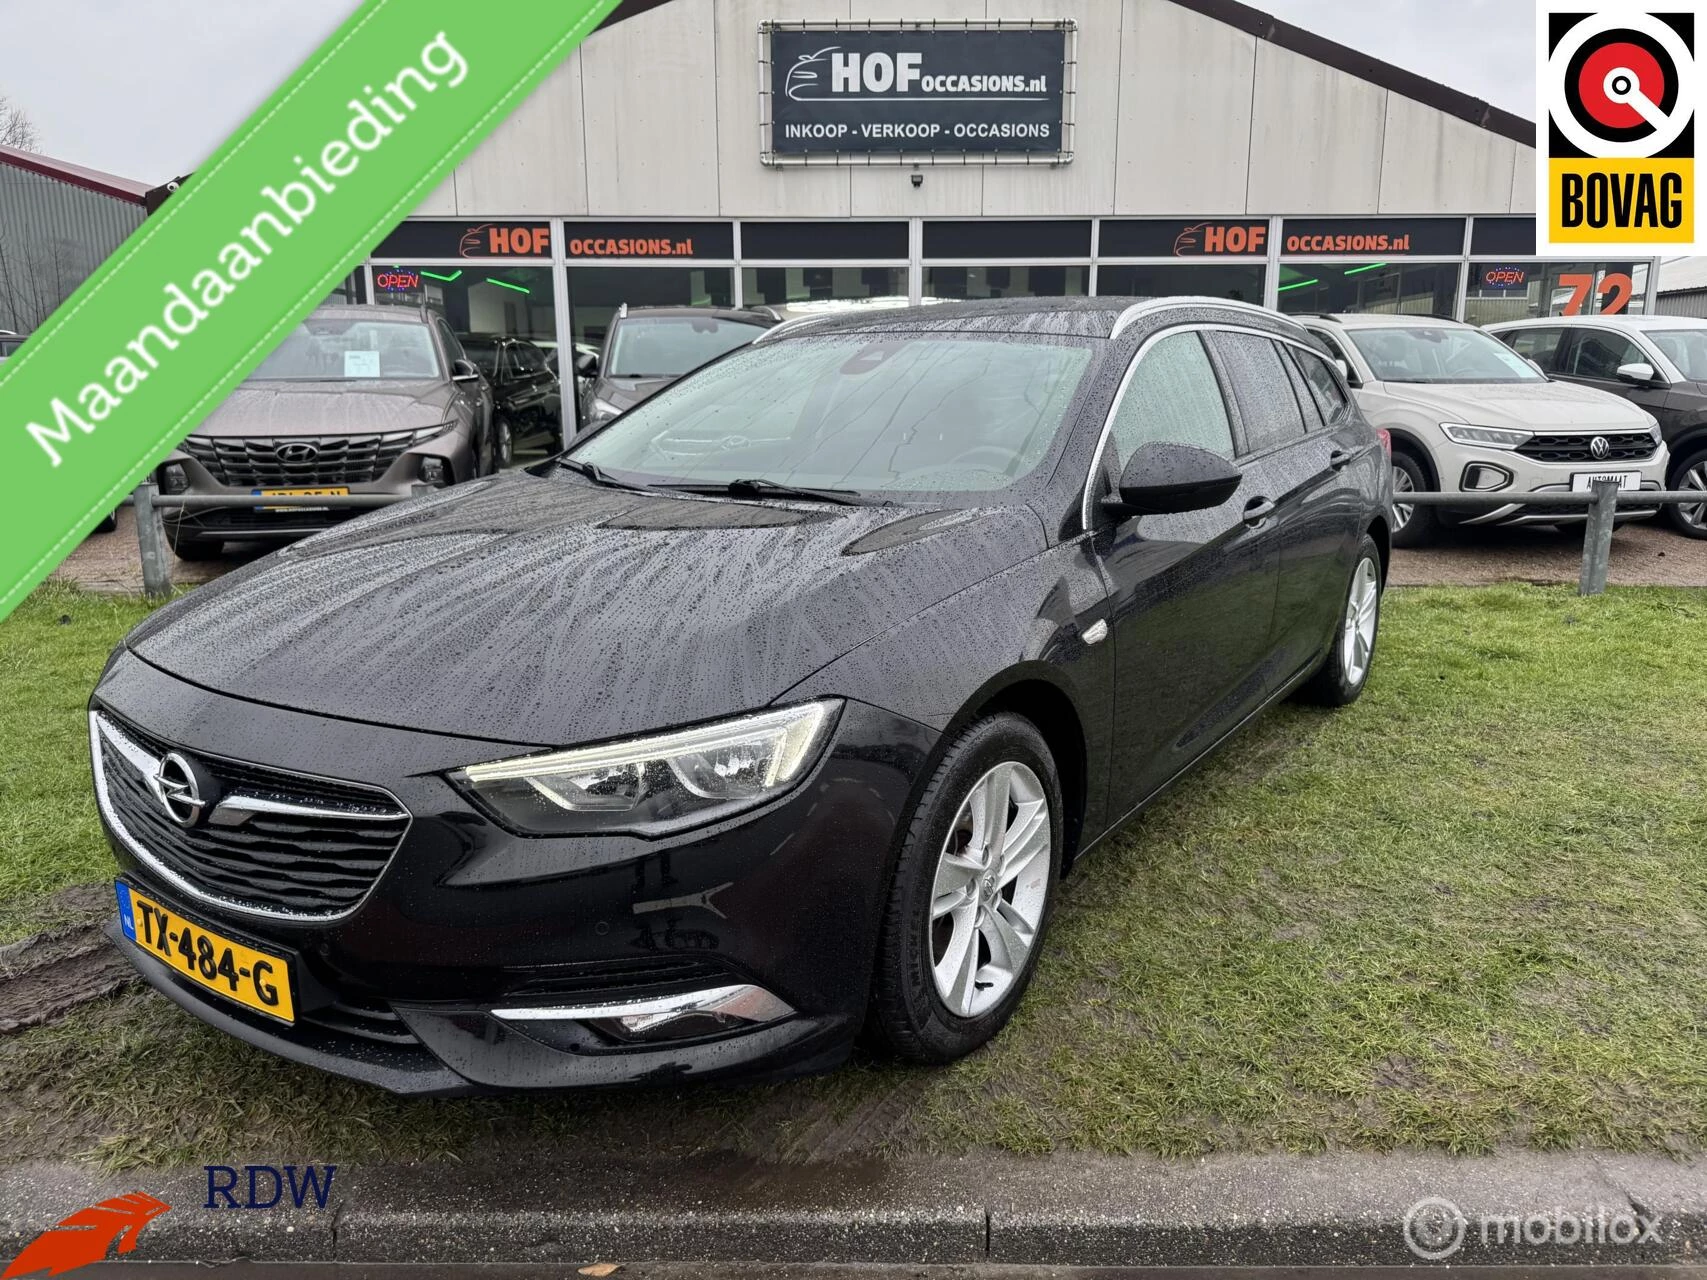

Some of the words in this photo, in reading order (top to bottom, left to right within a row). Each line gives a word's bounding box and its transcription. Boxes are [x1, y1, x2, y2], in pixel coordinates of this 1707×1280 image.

[831, 52, 923, 93] HOF
[921, 75, 1047, 93] OCCASIONS.nl
[785, 124, 848, 138] INKOOP
[861, 124, 941, 138] VERKOOP
[953, 124, 1050, 138] OCCASIONS
[488, 227, 550, 255] HOF
[569, 238, 694, 256] OCCASIONS.nl
[1204, 226, 1266, 253] HOF
[1286, 234, 1410, 251] OCCASIONS.nl
[377, 274, 419, 288] OPEN
[1485, 271, 1525, 283] OPEN
[1558, 272, 1633, 317] 72
[123, 913, 135, 930] NL
[136, 900, 279, 1006] TX-484-G
